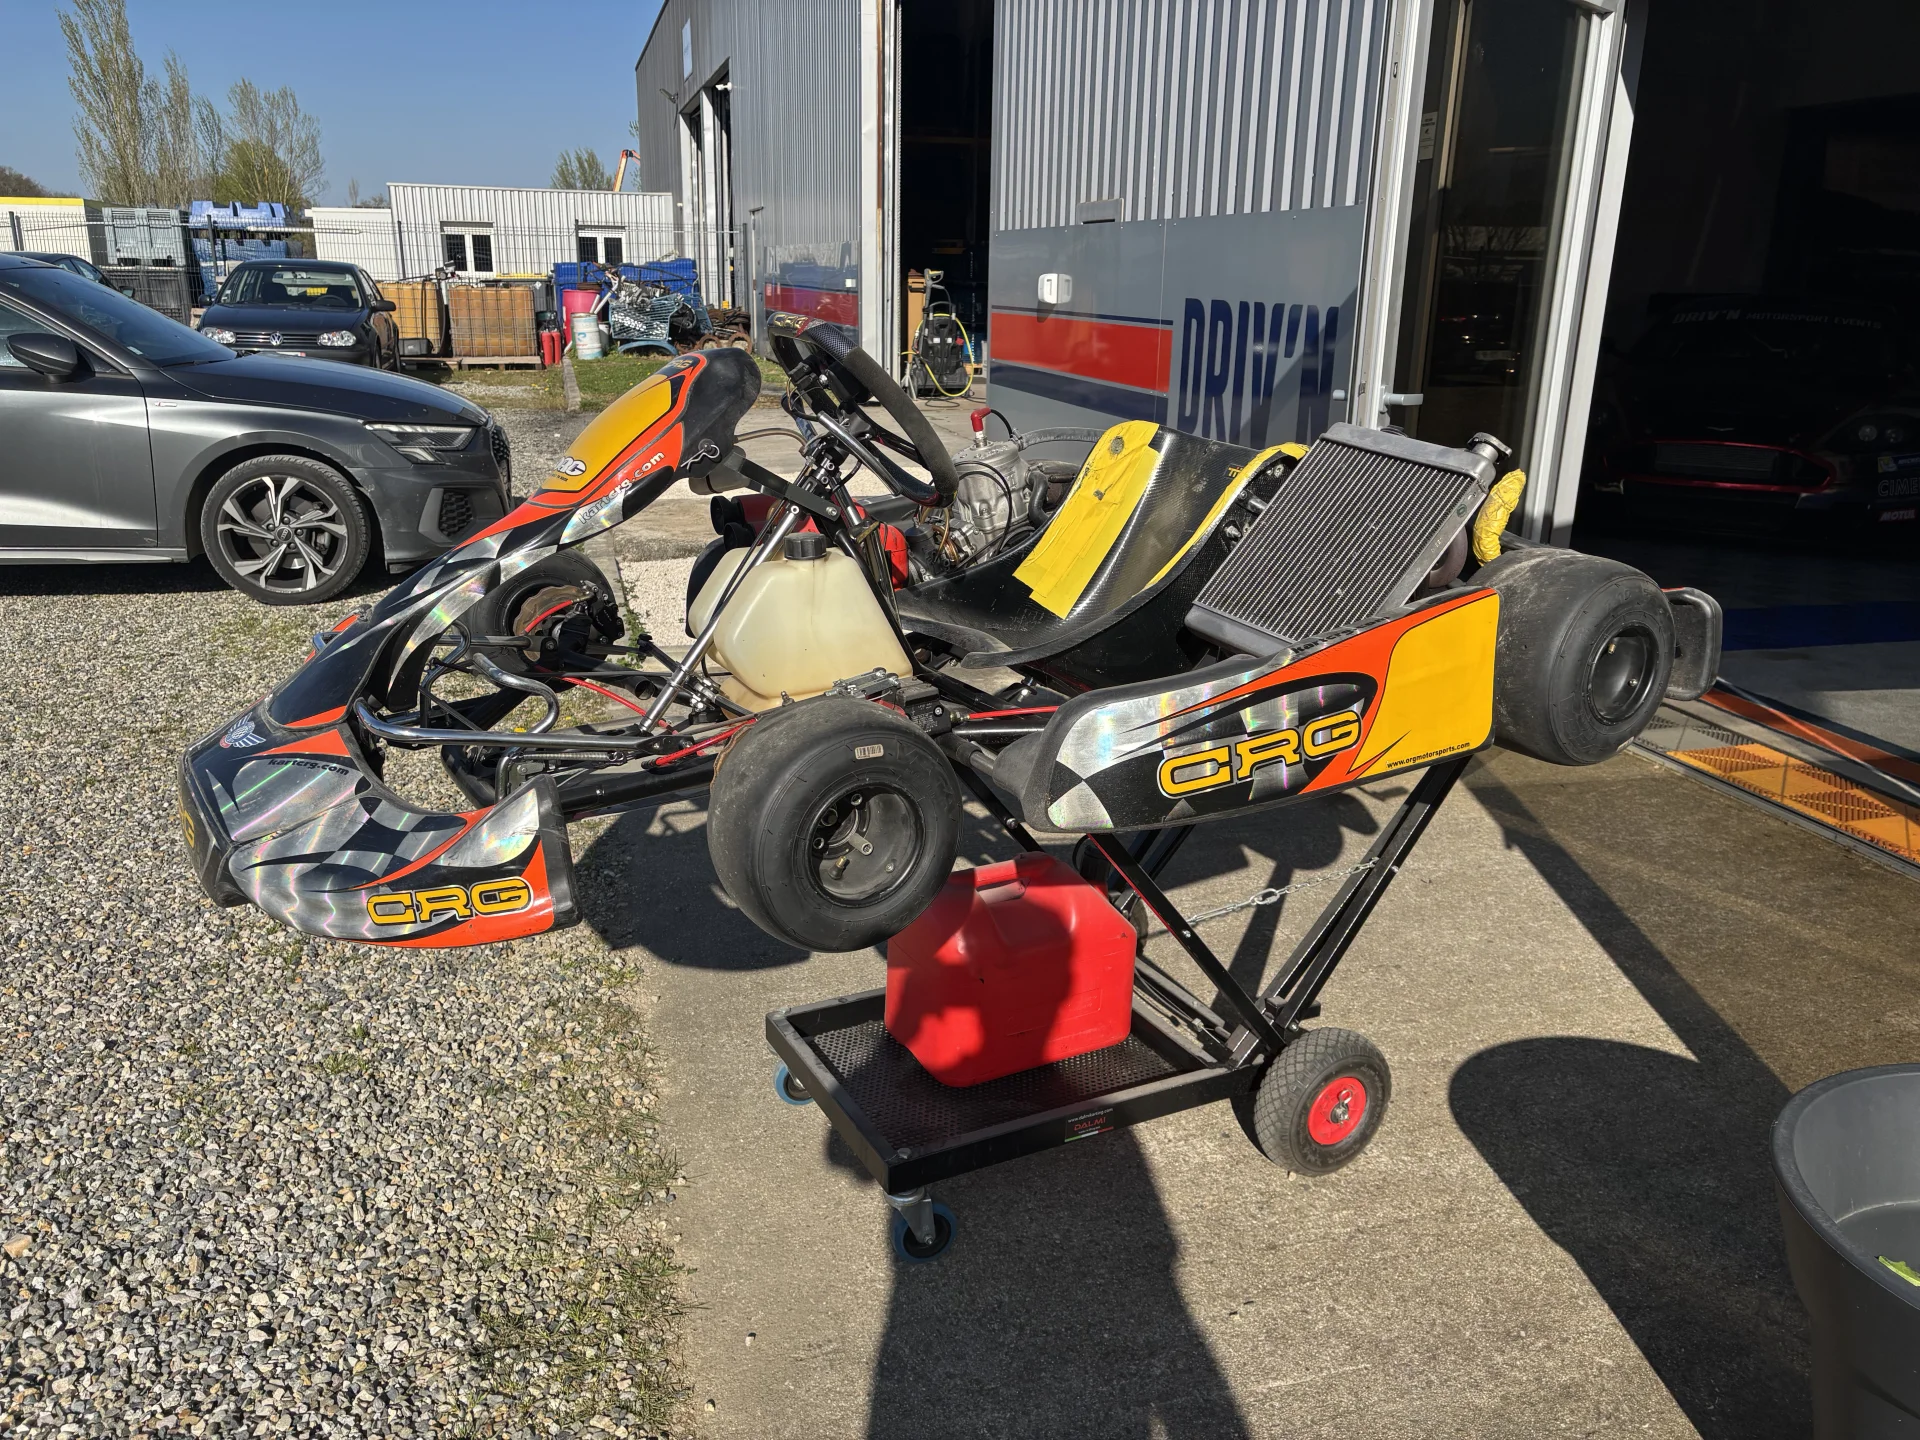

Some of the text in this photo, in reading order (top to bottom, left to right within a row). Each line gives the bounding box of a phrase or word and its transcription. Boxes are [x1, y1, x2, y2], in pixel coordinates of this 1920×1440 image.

[1671, 307, 1883, 330] DRIV'N MOTORSPORT EVENTS
[1177, 298, 1339, 449] DRIV'N
[1877, 477, 1920, 497] CIME
[1879, 509, 1916, 522] MOTUL
[1158, 710, 1362, 798] CRG
[267, 758, 350, 777] kartcrg.com
[366, 877, 534, 927] CRG
[1073, 1116, 1107, 1131] DALMI
